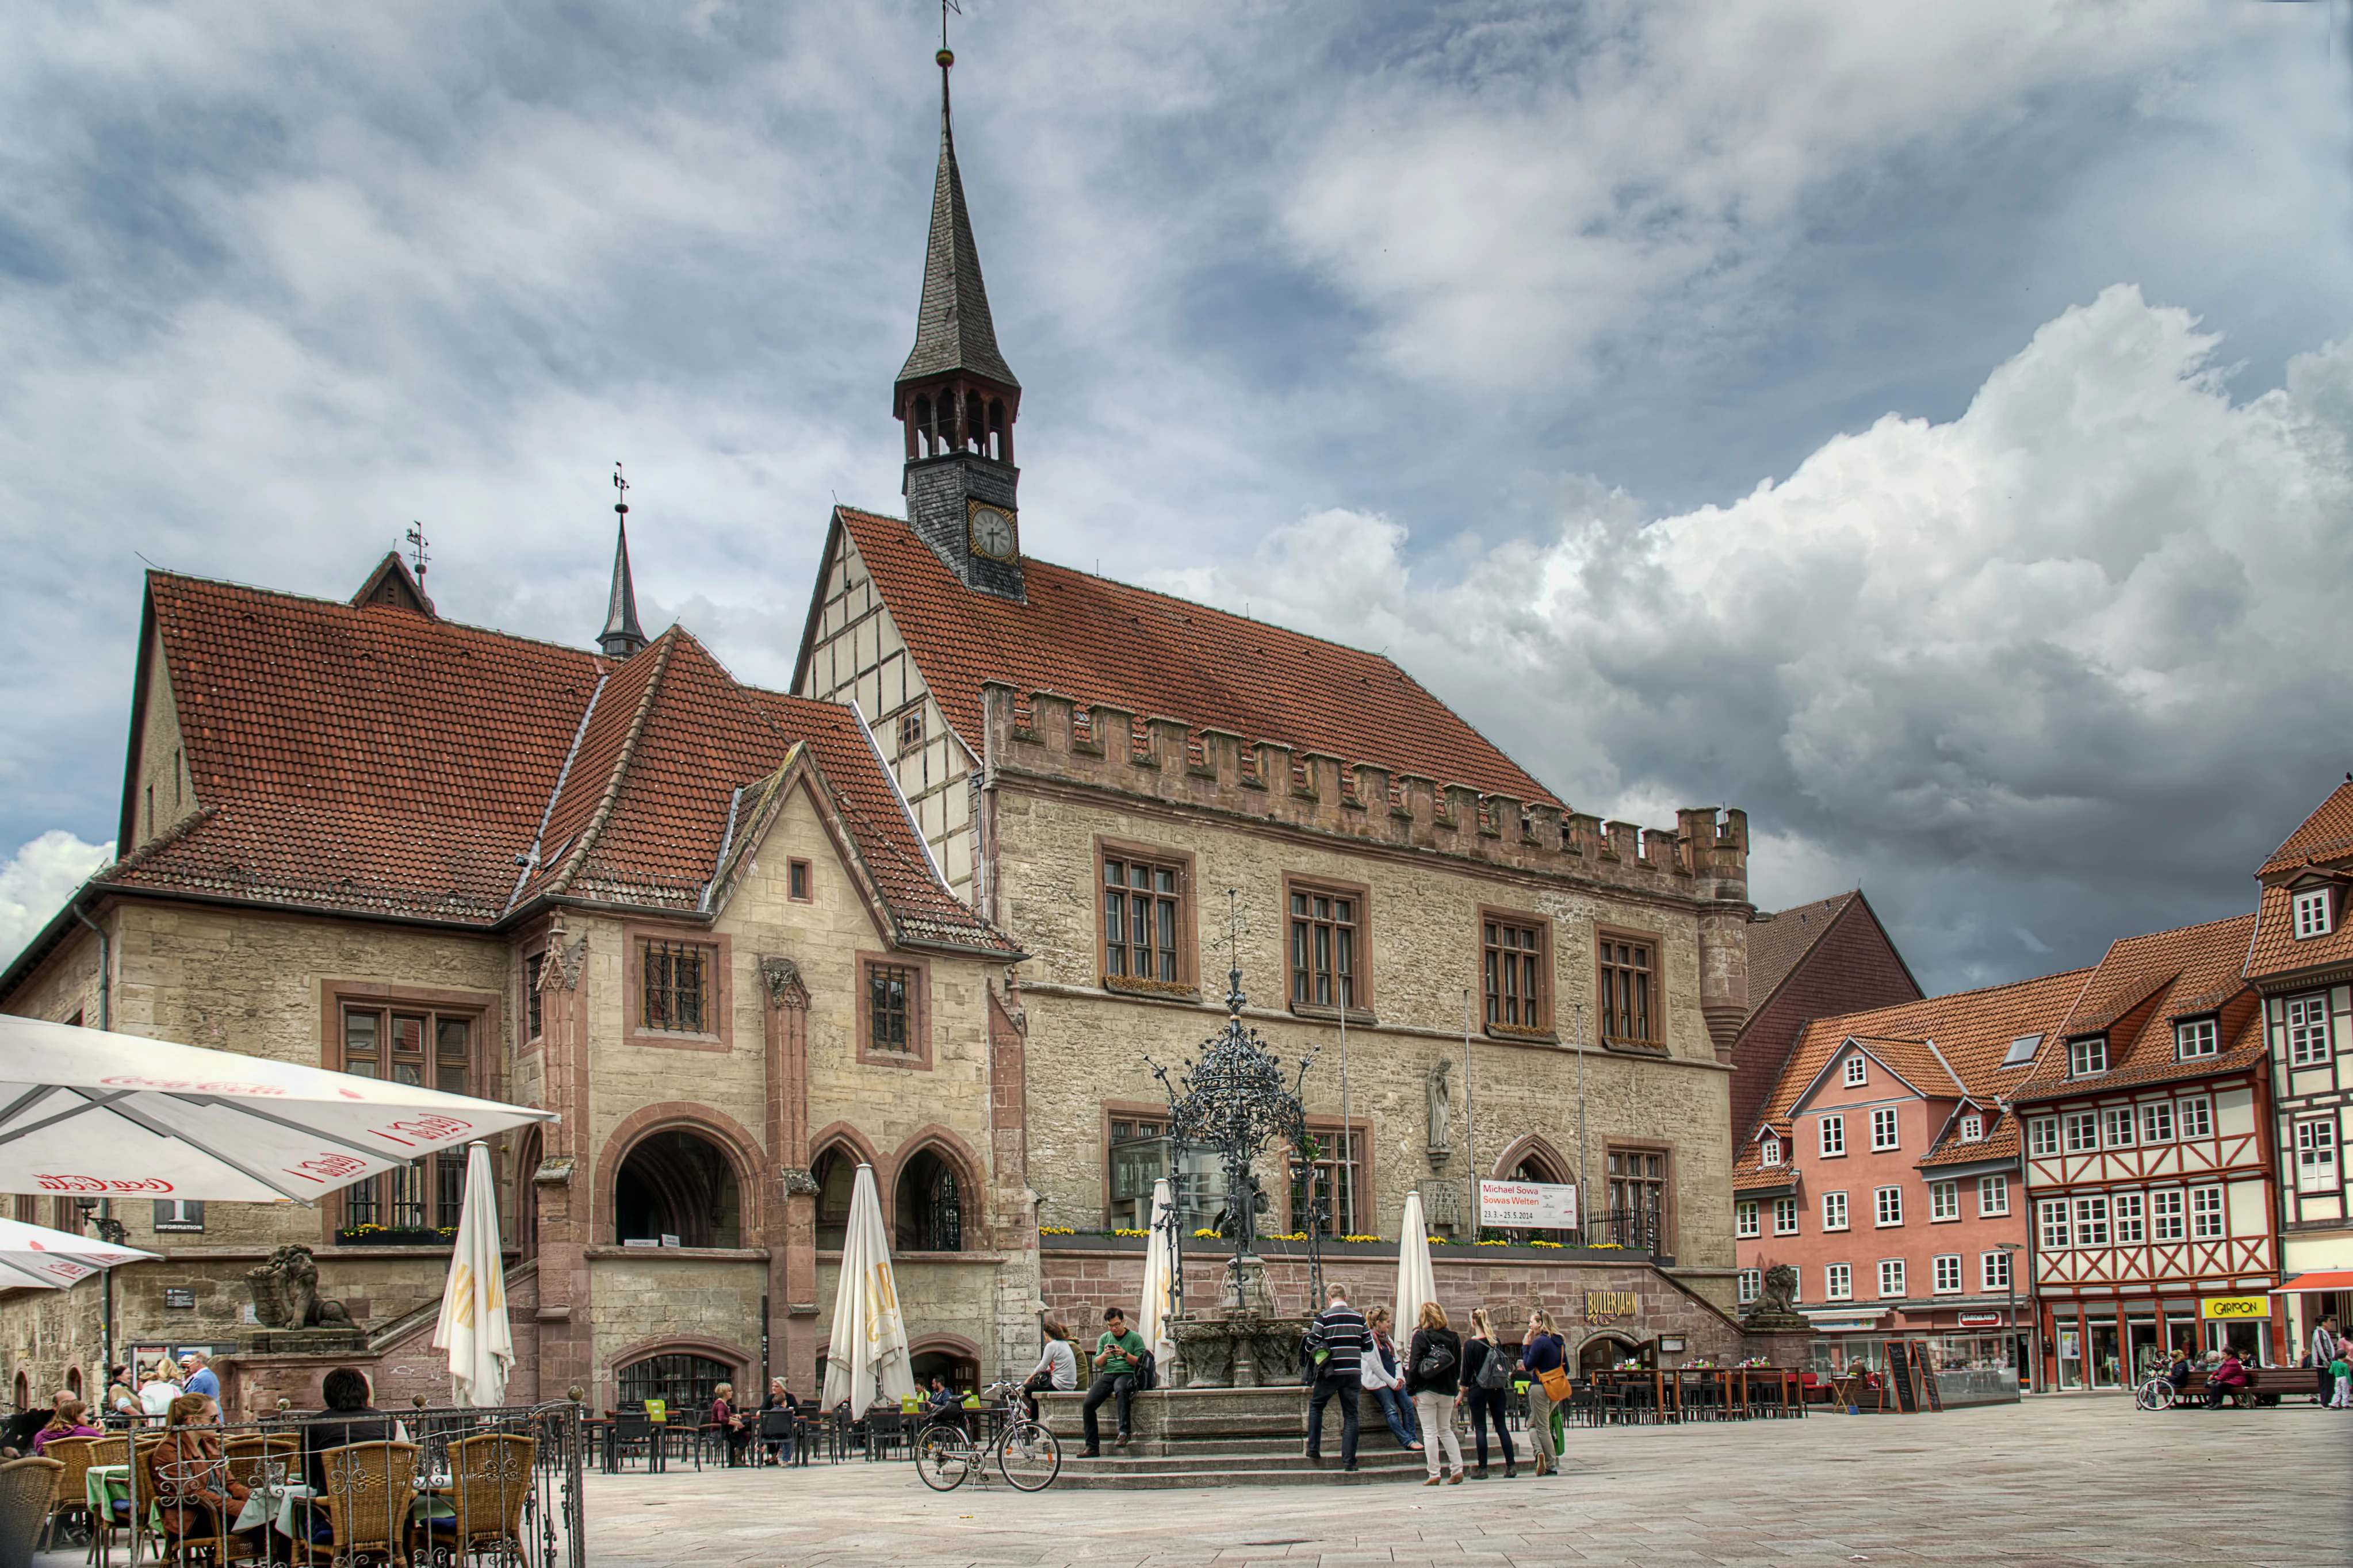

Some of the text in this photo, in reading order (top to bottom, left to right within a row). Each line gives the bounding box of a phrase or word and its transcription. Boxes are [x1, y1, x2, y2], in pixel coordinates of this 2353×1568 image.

[1483, 1184, 1514, 1194] Michael
[1517, 1186, 1539, 1195] Sowa
[1483, 1196, 1510, 1204] Sowas
[1512, 1197, 1539, 1205] Welten
[1587, 1291, 1637, 1317] BULLERJAHN
[2214, 1301, 2257, 1315] CARTOON
